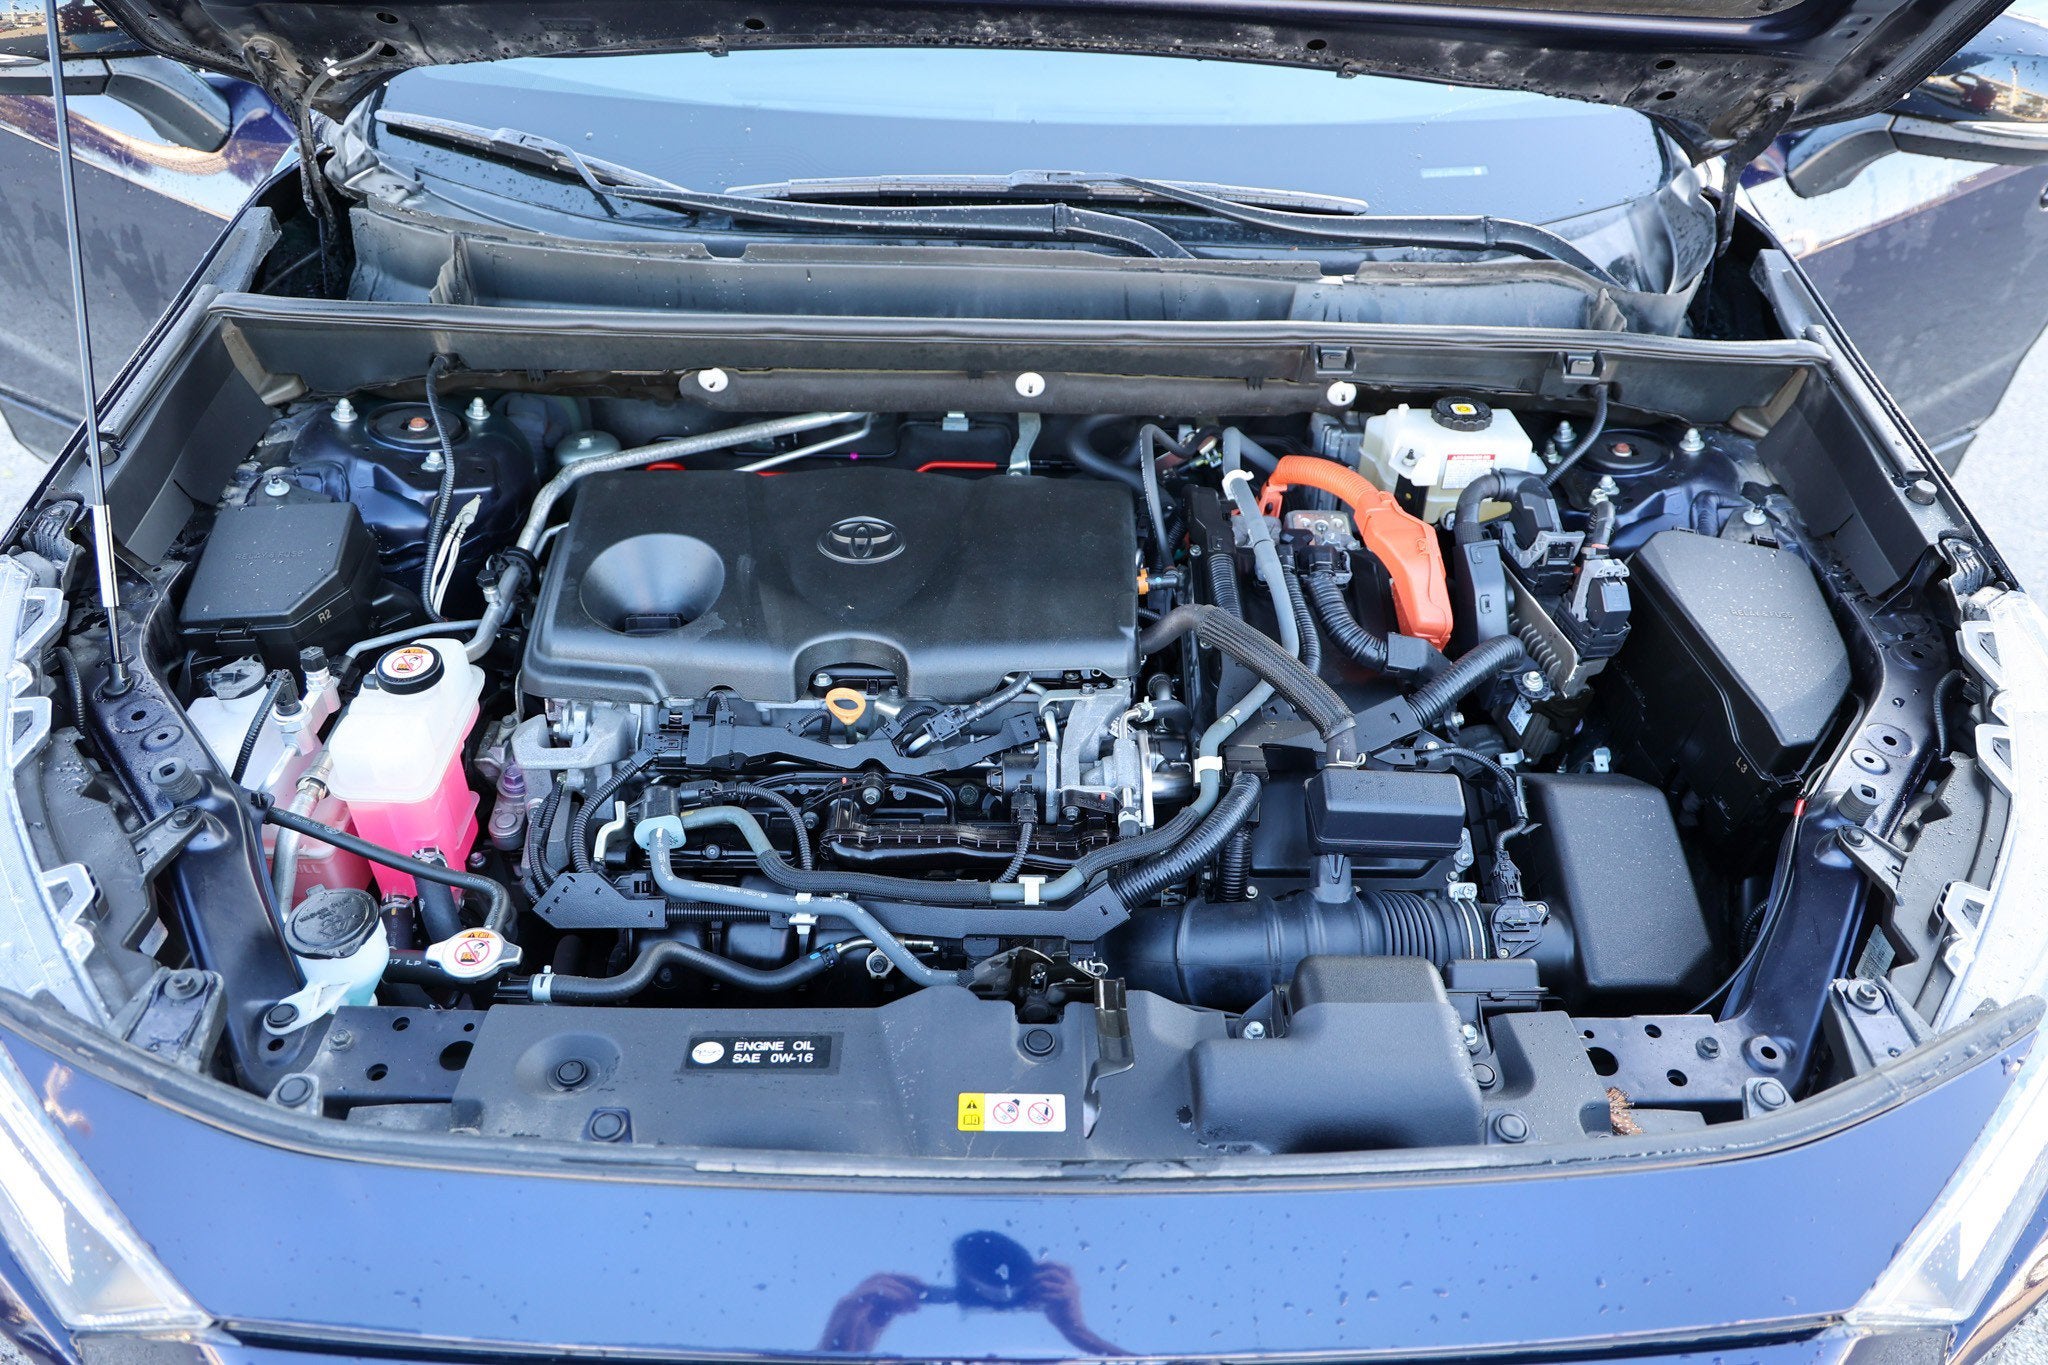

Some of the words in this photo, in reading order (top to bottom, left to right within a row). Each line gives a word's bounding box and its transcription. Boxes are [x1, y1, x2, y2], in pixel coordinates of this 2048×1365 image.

[317, 608, 332, 624] R2
[1730, 609, 1759, 617] RELAY
[1769, 611, 1794, 619] FUSE
[1735, 757, 1748, 774] L3
[405, 959, 422, 967] LP
[734, 1041, 784, 1051] ENGINE
[792, 1041, 815, 1051] OIL
[732, 1053, 761, 1063] SAE
[769, 1053, 814, 1063] 0W-16
